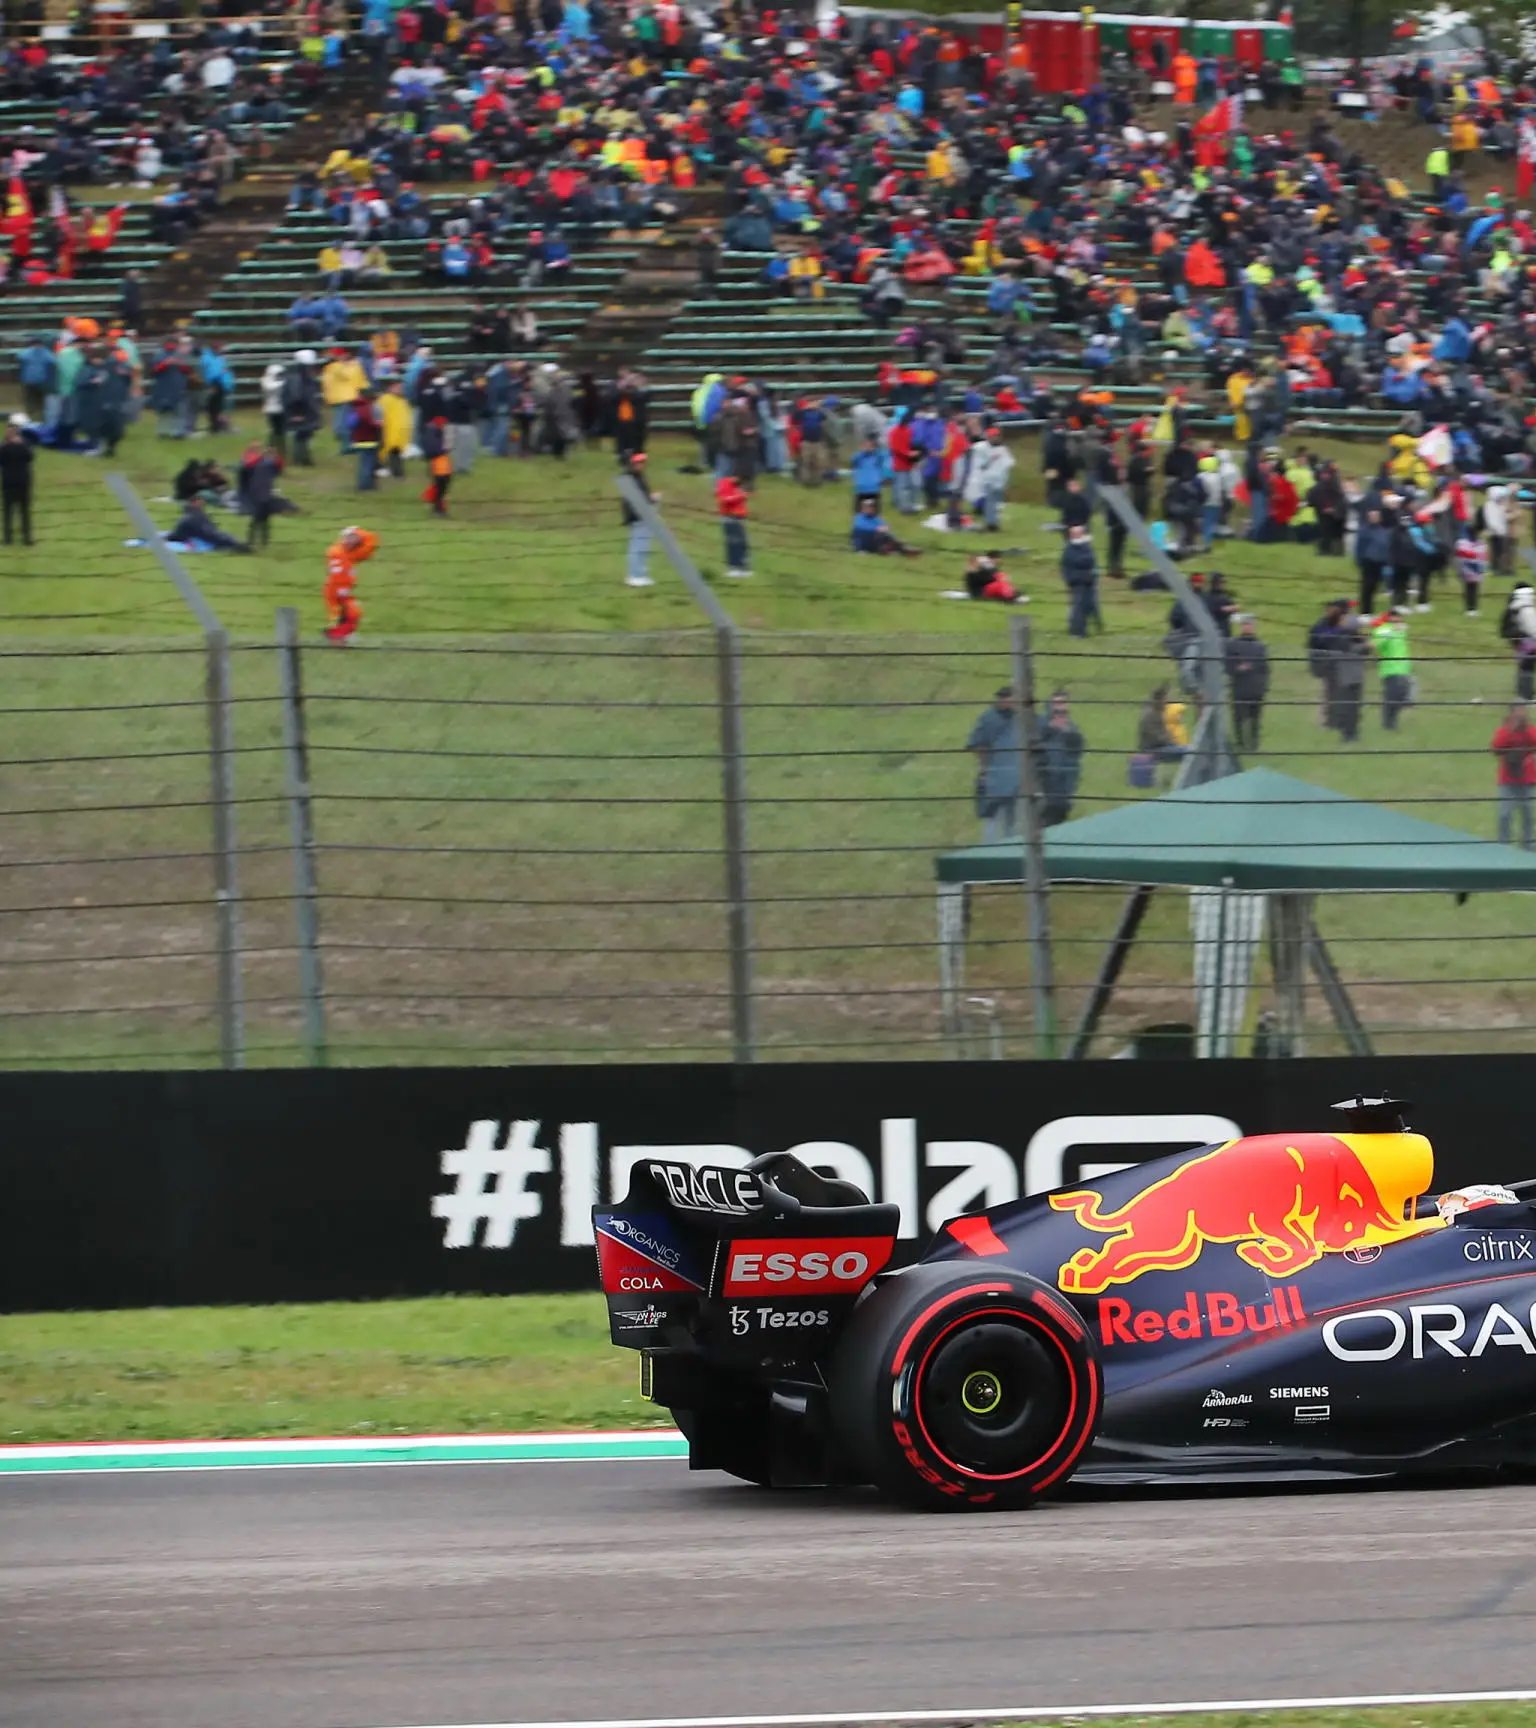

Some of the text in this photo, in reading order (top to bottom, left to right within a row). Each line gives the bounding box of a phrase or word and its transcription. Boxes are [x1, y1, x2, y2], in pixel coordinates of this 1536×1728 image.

[1463, 1231, 1535, 1262] citrix
[730, 1251, 868, 1282] ESSO
[620, 1277, 664, 1290] COLA
[756, 1307, 829, 1329] Tezos
[1099, 1285, 1307, 1346] Red Bull
[1269, 1386, 1330, 1399] SIEMENS
